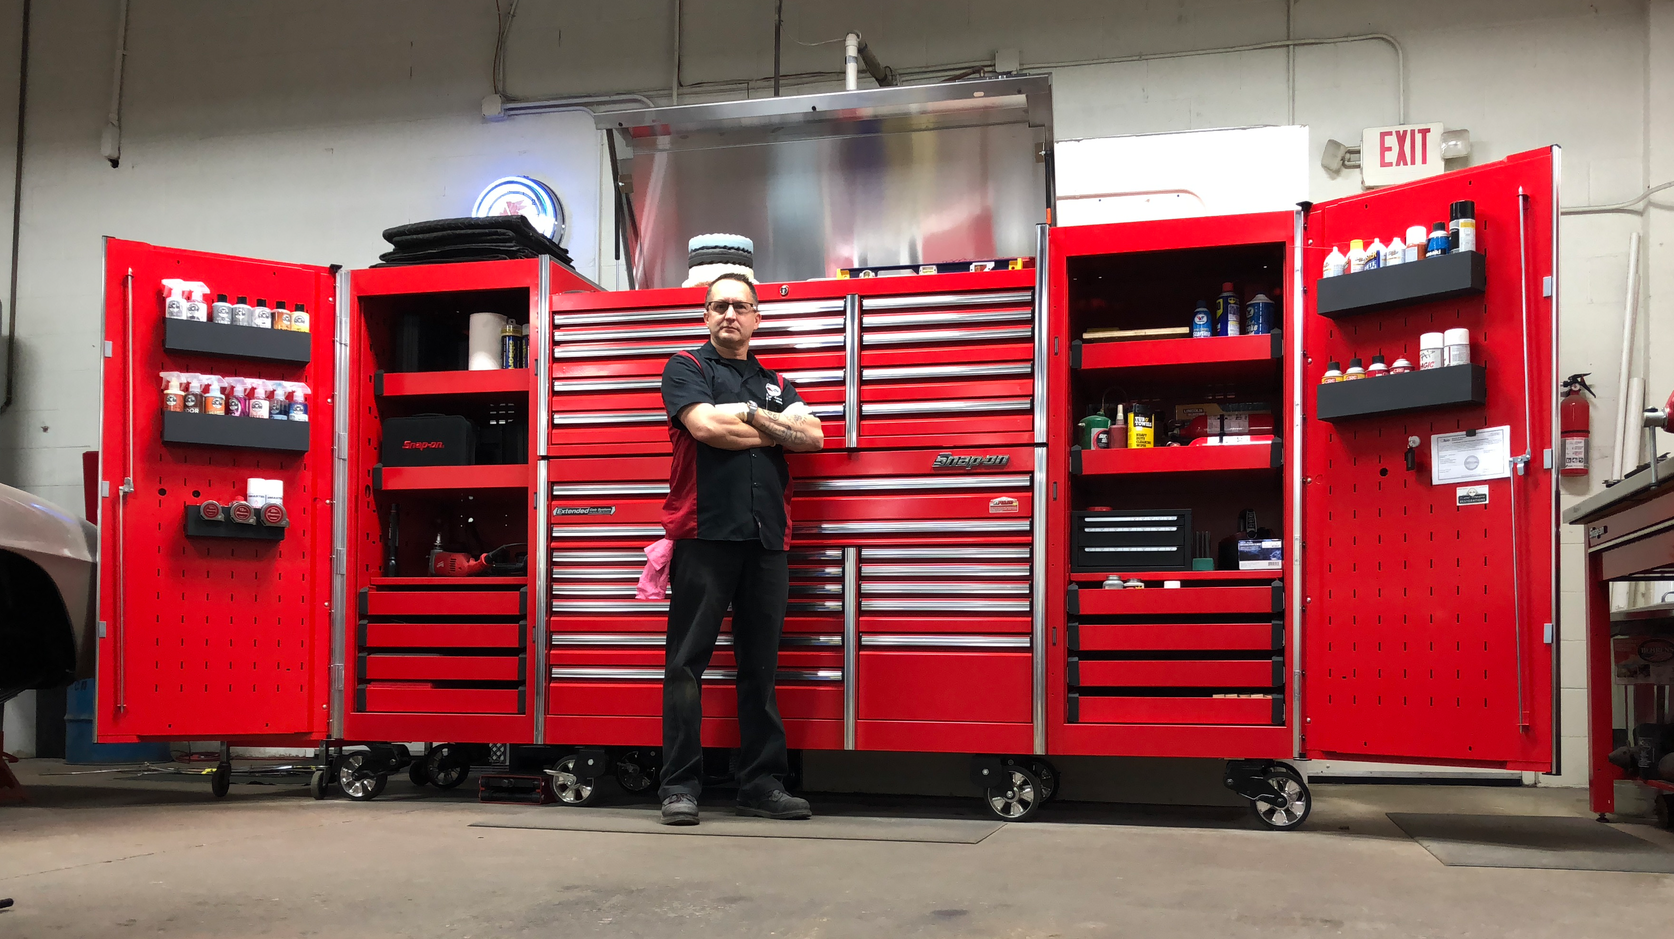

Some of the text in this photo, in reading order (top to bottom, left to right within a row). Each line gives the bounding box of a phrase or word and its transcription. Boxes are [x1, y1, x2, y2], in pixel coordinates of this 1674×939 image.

[1380, 128, 1431, 168] EXIT
[402, 440, 445, 451] Snap-on
[932, 452, 1010, 470] Snap-on
